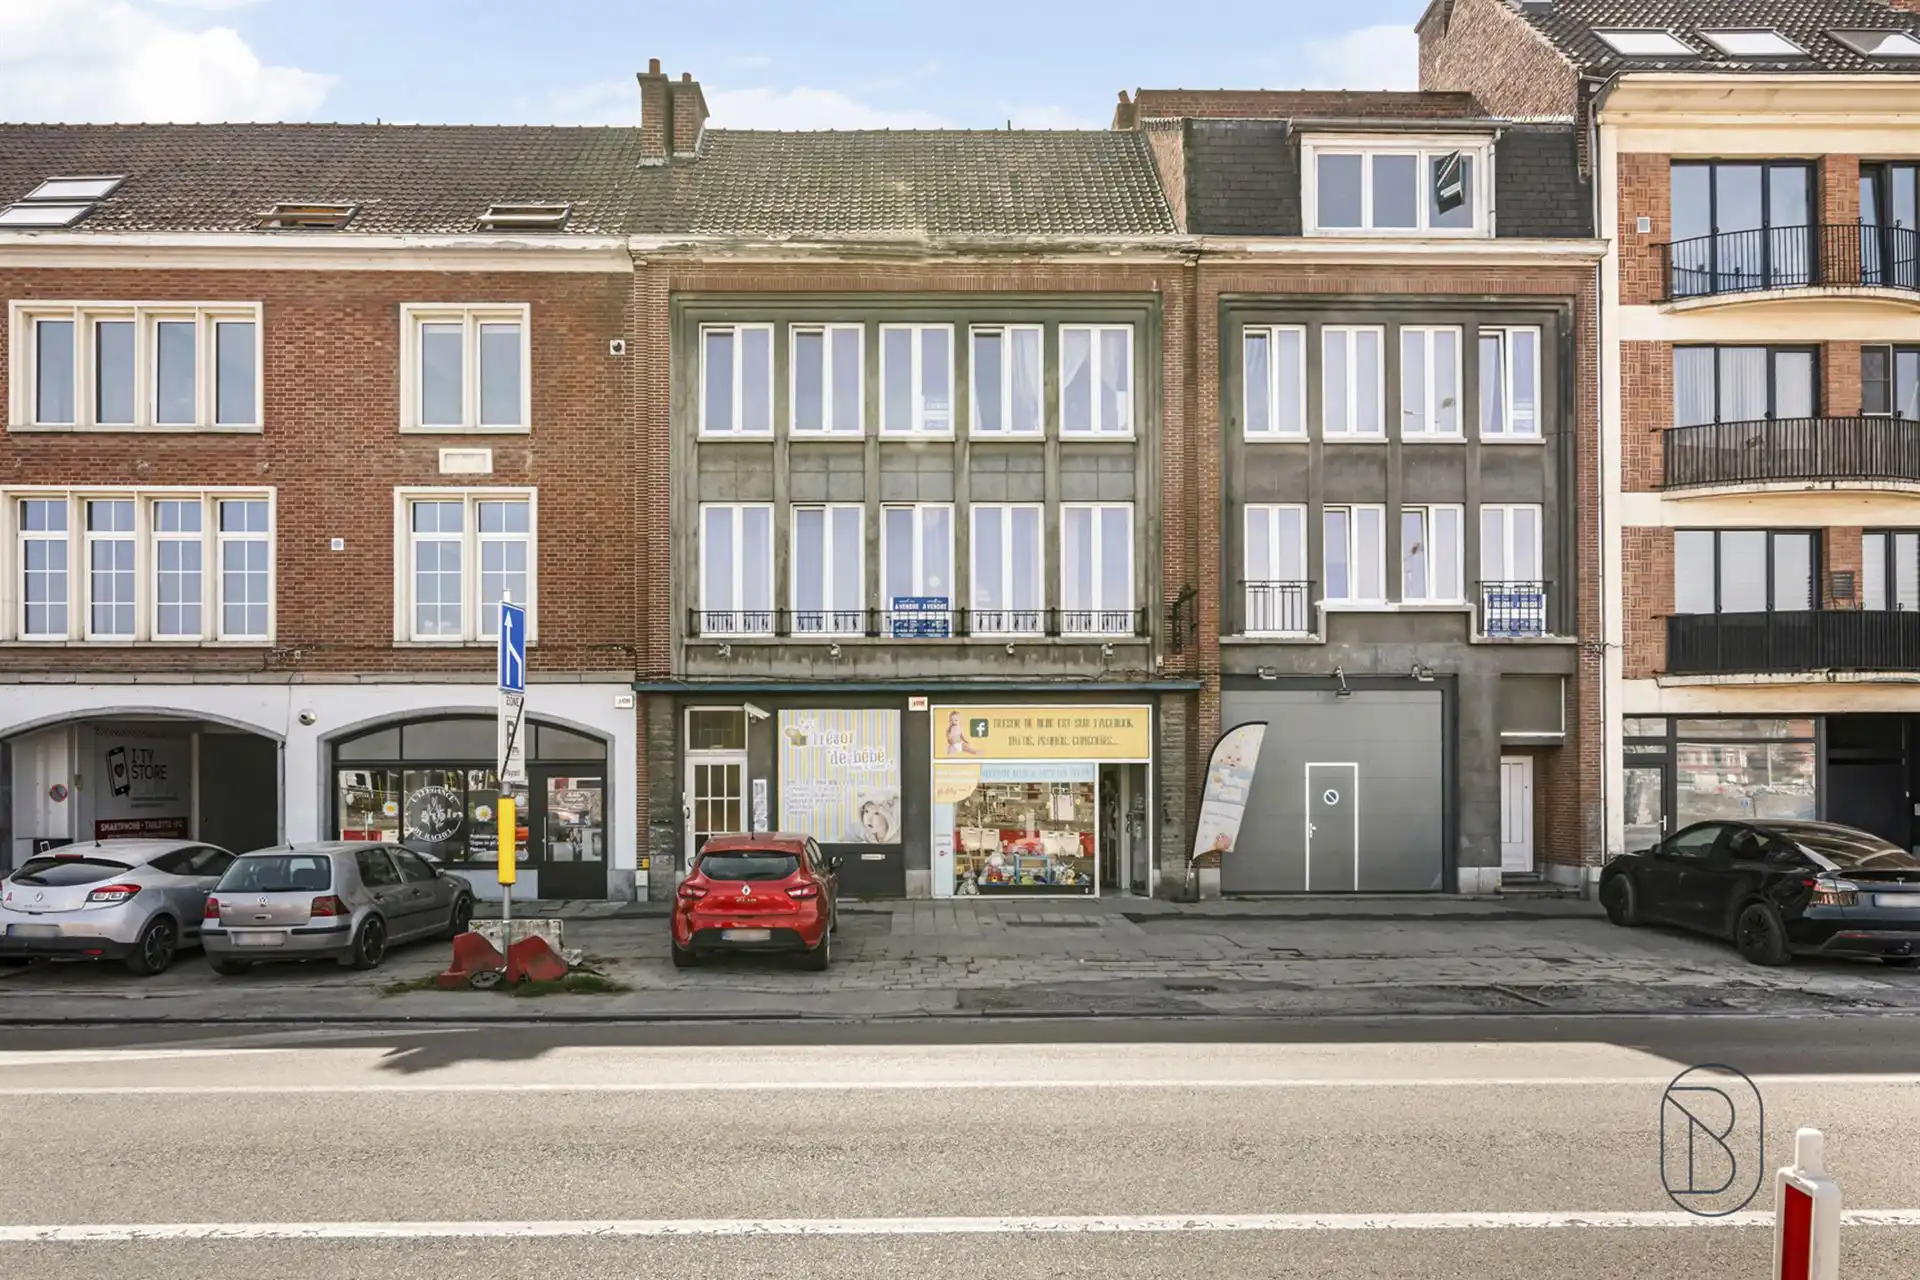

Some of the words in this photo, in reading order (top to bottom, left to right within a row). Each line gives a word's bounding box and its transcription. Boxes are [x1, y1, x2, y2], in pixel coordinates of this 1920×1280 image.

[506, 695, 520, 707] ZONE
[1057, 718, 1071, 728] EST
[1074, 718, 1090, 728] SUR
[131, 764, 167, 780] STORE
